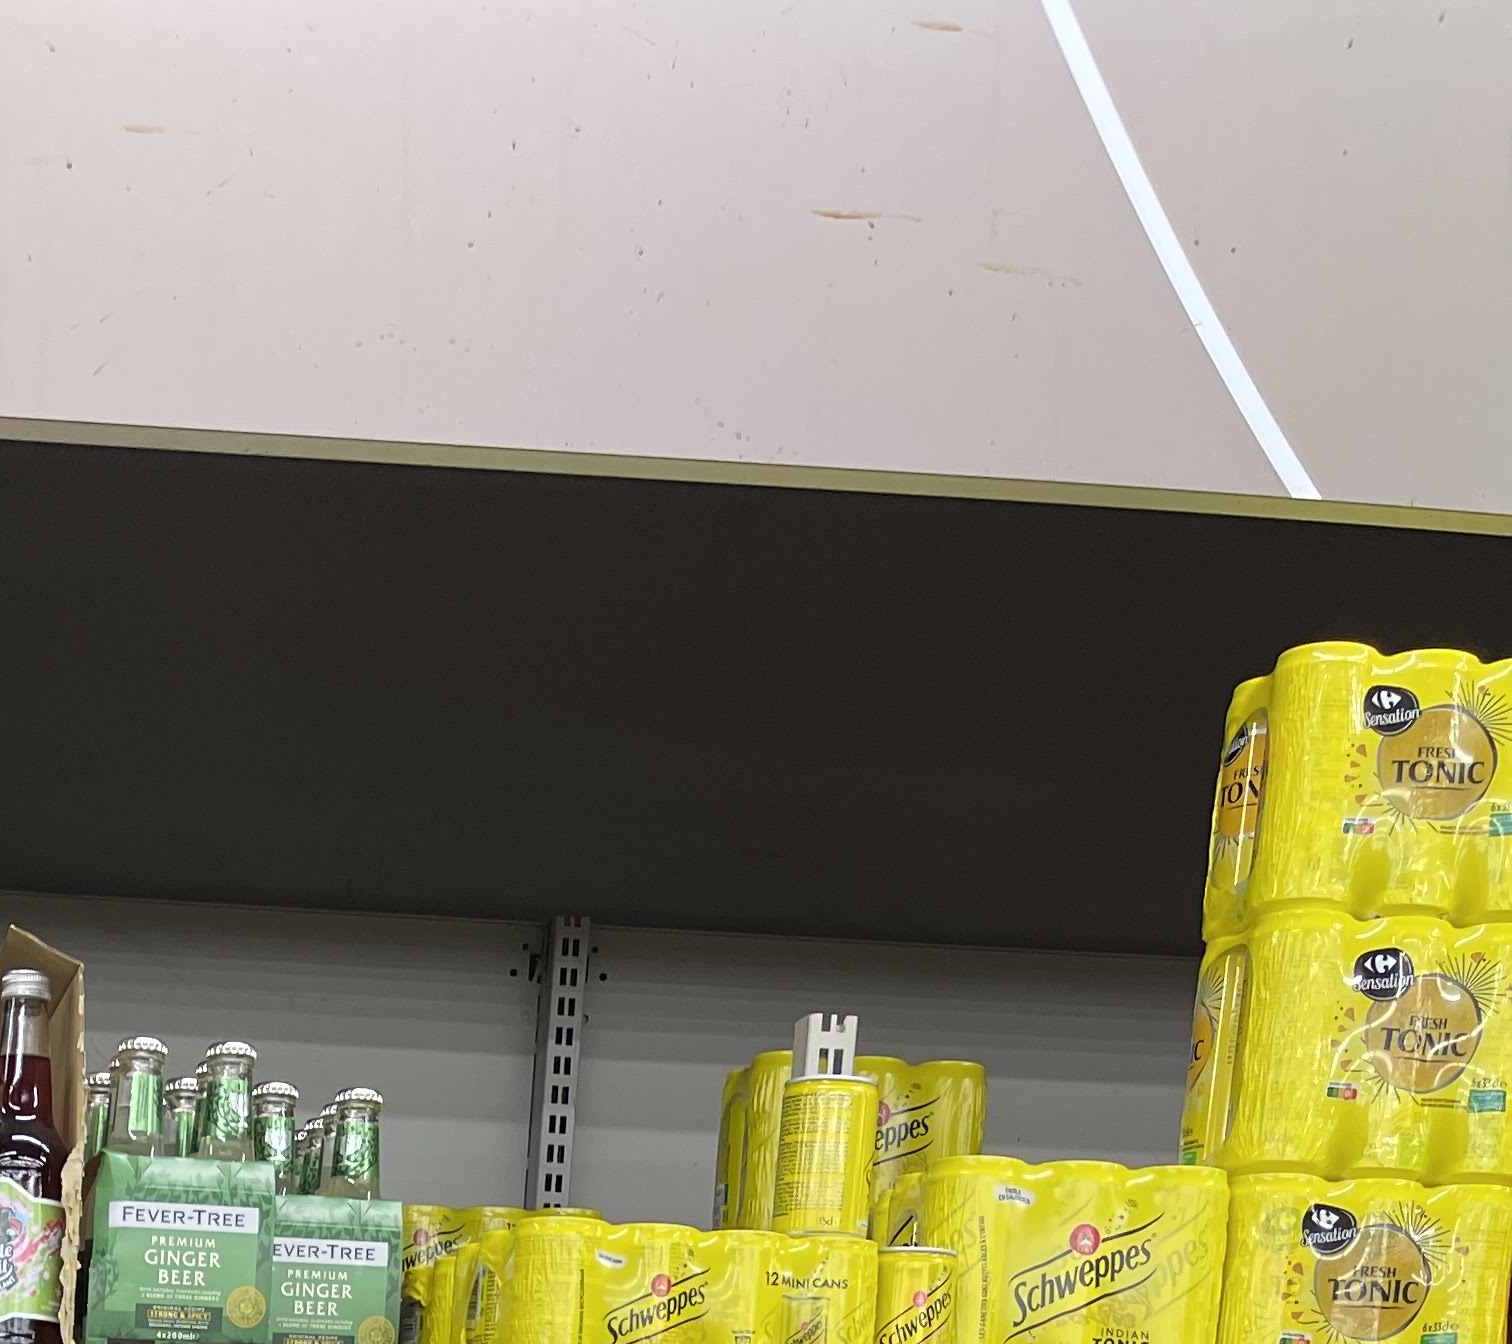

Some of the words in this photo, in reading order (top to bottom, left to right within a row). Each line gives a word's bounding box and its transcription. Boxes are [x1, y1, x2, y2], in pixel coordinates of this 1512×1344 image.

[1363, 706, 1420, 728] Sensation
[1392, 758, 1485, 785] TONIC
[122, 1206, 246, 1228] FEVER-TREE
[152, 1235, 216, 1248] PREMIUM
[1302, 1227, 1359, 1245] Sensation
[144, 1249, 220, 1269] GINGER
[158, 1269, 205, 1286] BEER
[765, 1271, 778, 1285] 12
[782, 1275, 809, 1288] MINI
[813, 1277, 848, 1291] CANS
[1012, 1236, 1153, 1328] Schweppes
[1329, 1279, 1420, 1304] TONIC
[1100, 1328, 1150, 1339] INDIAN
